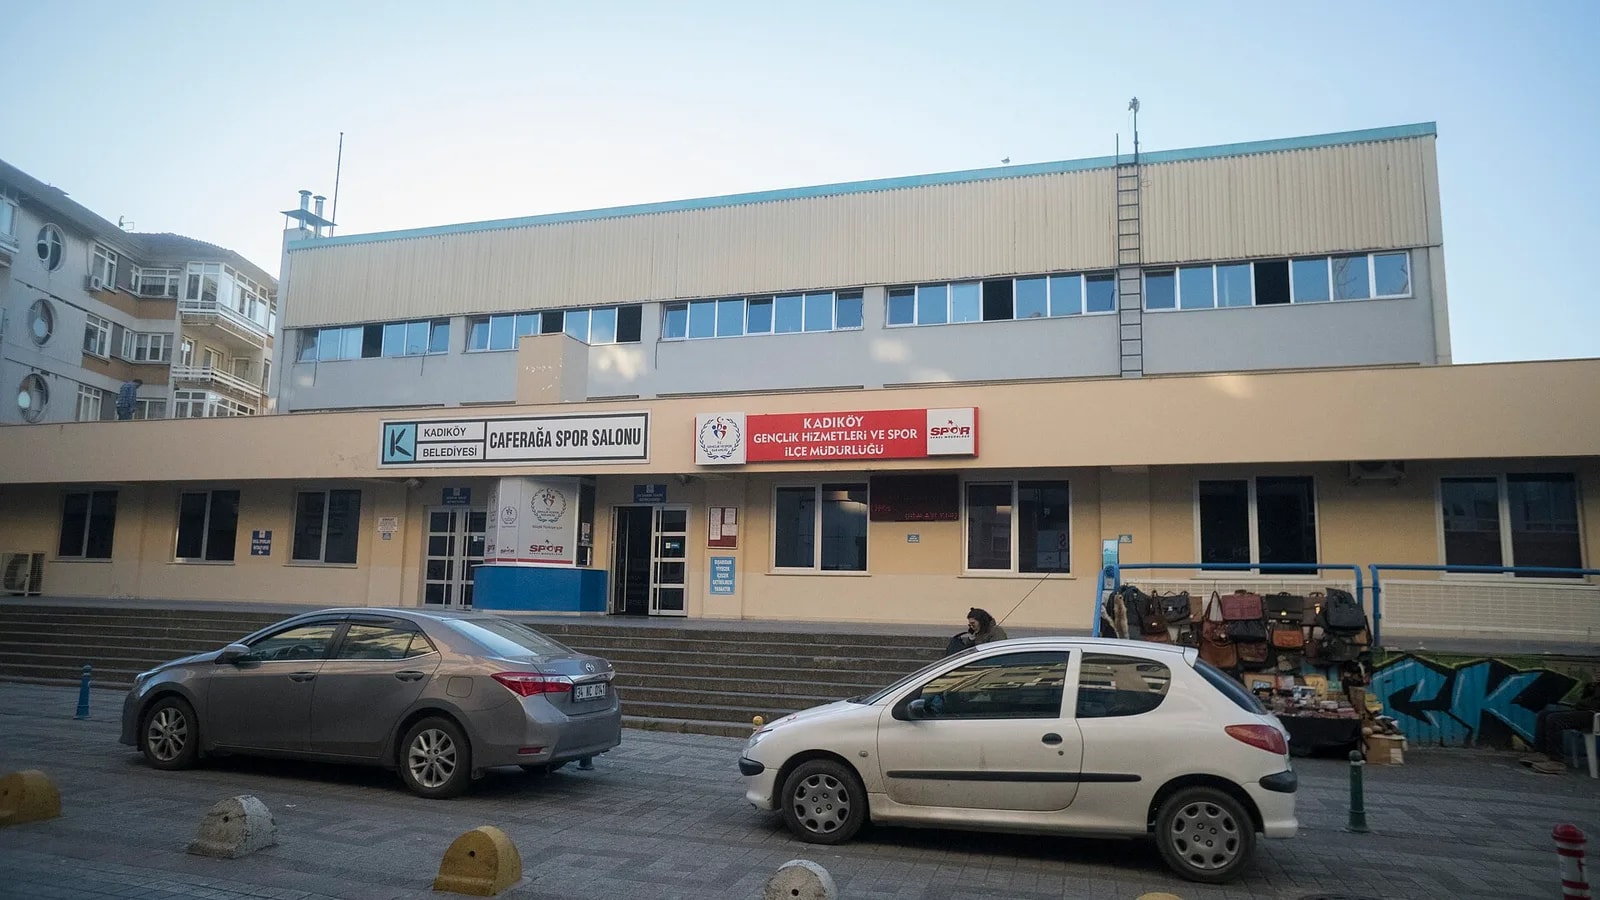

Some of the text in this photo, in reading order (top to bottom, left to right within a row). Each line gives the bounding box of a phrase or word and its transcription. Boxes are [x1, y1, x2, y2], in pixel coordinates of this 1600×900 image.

[803, 414, 864, 429] KADIKÖY
[423, 425, 467, 437] KADIKÖY
[870, 429, 885, 440] VE
[887, 428, 918, 440] SPOR
[930, 424, 970, 436] SPOR
[489, 426, 641, 449] CAFERAĞA SPOR SALONU
[423, 445, 477, 457] BELEDİYESİ
[784, 443, 884, 457] İLÇE MÜDÜRLÜĞÜ
[529, 544, 563, 553] SPOR
[577, 687, 583, 698] 34
